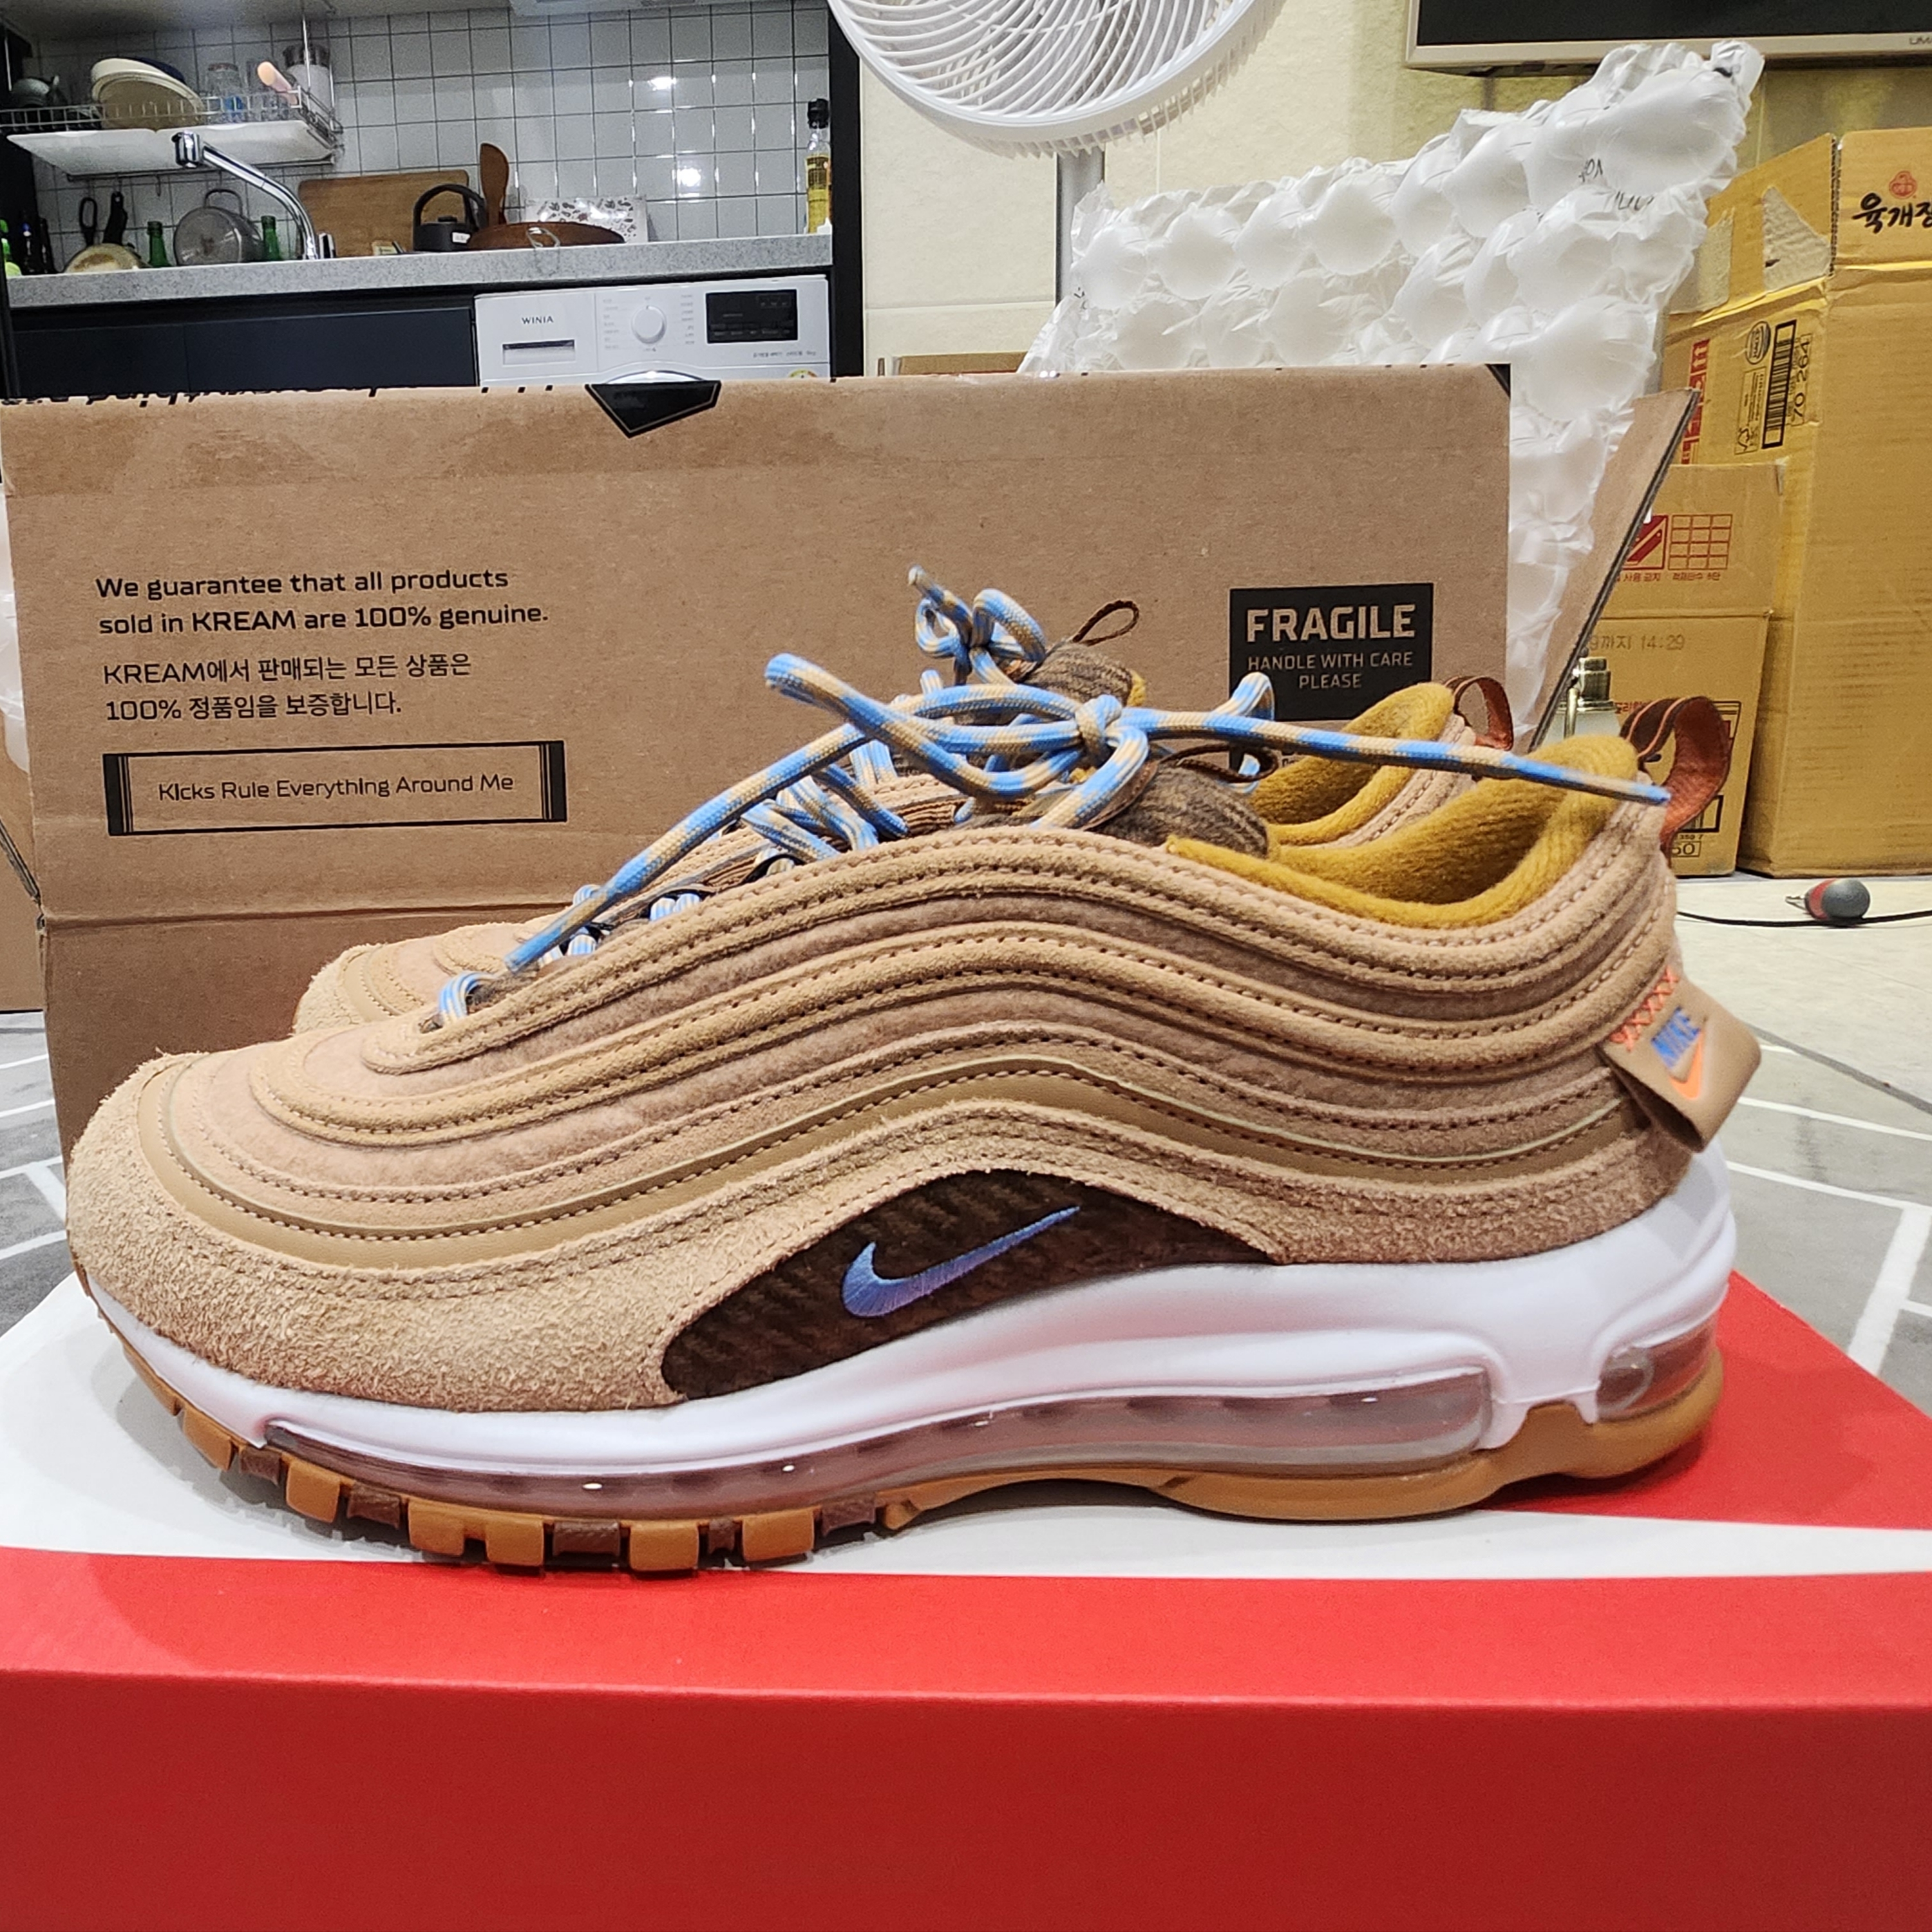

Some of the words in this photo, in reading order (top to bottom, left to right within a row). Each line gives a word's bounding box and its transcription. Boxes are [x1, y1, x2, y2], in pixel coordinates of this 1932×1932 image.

[521, 316, 554, 325] WINIA
[95, 578, 138, 598] We
[147, 576, 282, 601] guarantee
[289, 573, 346, 592] that
[354, 571, 382, 591] all
[391, 569, 509, 594] products
[99, 614, 153, 634] sold
[161, 612, 184, 633] in
[192, 610, 296, 632] KREAM
[304, 613, 346, 629] are
[355, 606, 431, 628] 100%
[439, 603, 548, 630] genuine.
[1247, 605, 1415, 642] FRAGILE
[104, 658, 250, 685] KREAM에서
[258, 656, 347, 681] 판매되는
[354, 655, 399, 678] 모든
[406, 653, 471, 677] 상품은
[1248, 654, 1316, 670] HANDLE
[1320, 652, 1363, 668] WITH
[1370, 651, 1412, 667] CARE
[1299, 674, 1361, 689] PLEASE
[106, 699, 182, 721] 100%
[189, 695, 279, 720] 정품임을
[285, 690, 401, 717] 보증합니다.
[222, 781, 269, 799] Rule
[395, 775, 473, 793] Around
[480, 773, 513, 791] Me
